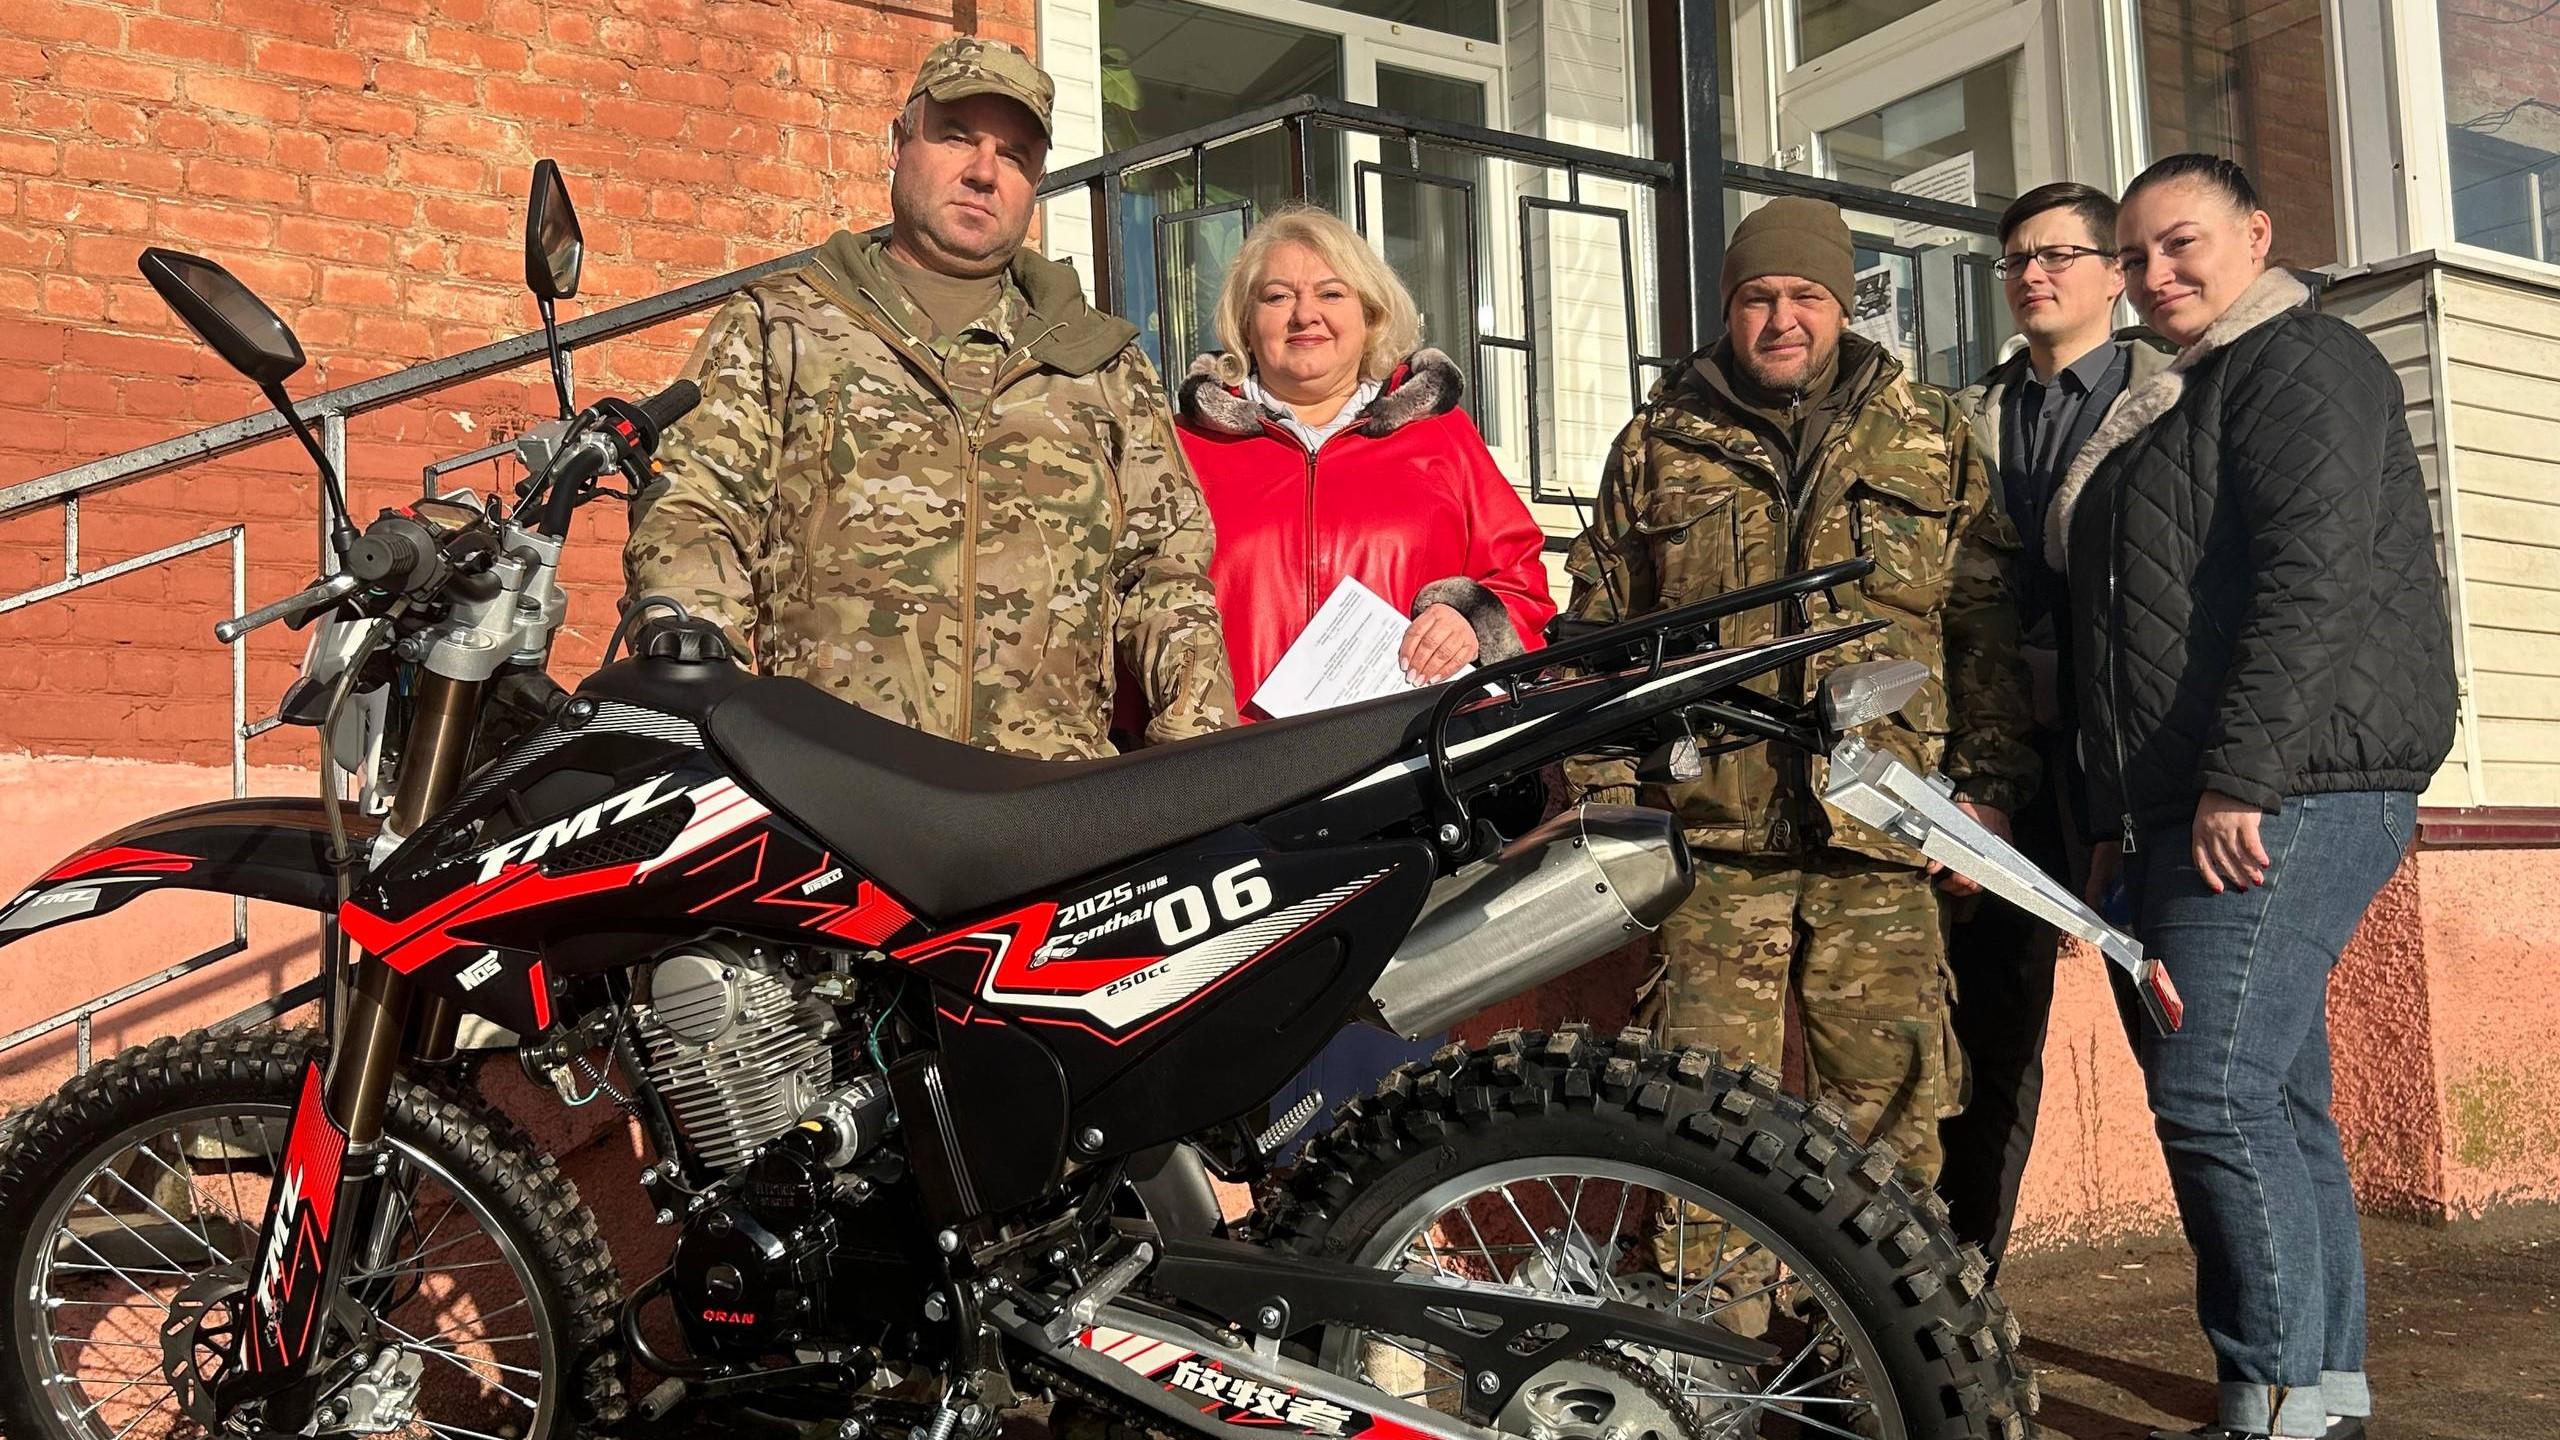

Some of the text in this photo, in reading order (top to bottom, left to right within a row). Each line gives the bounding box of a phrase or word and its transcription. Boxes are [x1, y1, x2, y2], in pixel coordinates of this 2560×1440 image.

[477, 771, 689, 885] FMZ
[31, 889, 94, 907] FMZ
[1057, 882, 1131, 928] 2025
[1154, 858, 1273, 946] 06
[456, 950, 502, 991] NOS
[1107, 963, 1171, 997] 250cc
[257, 1162, 303, 1317] FMZ
[1170, 1361, 1352, 1437] 放牧者
